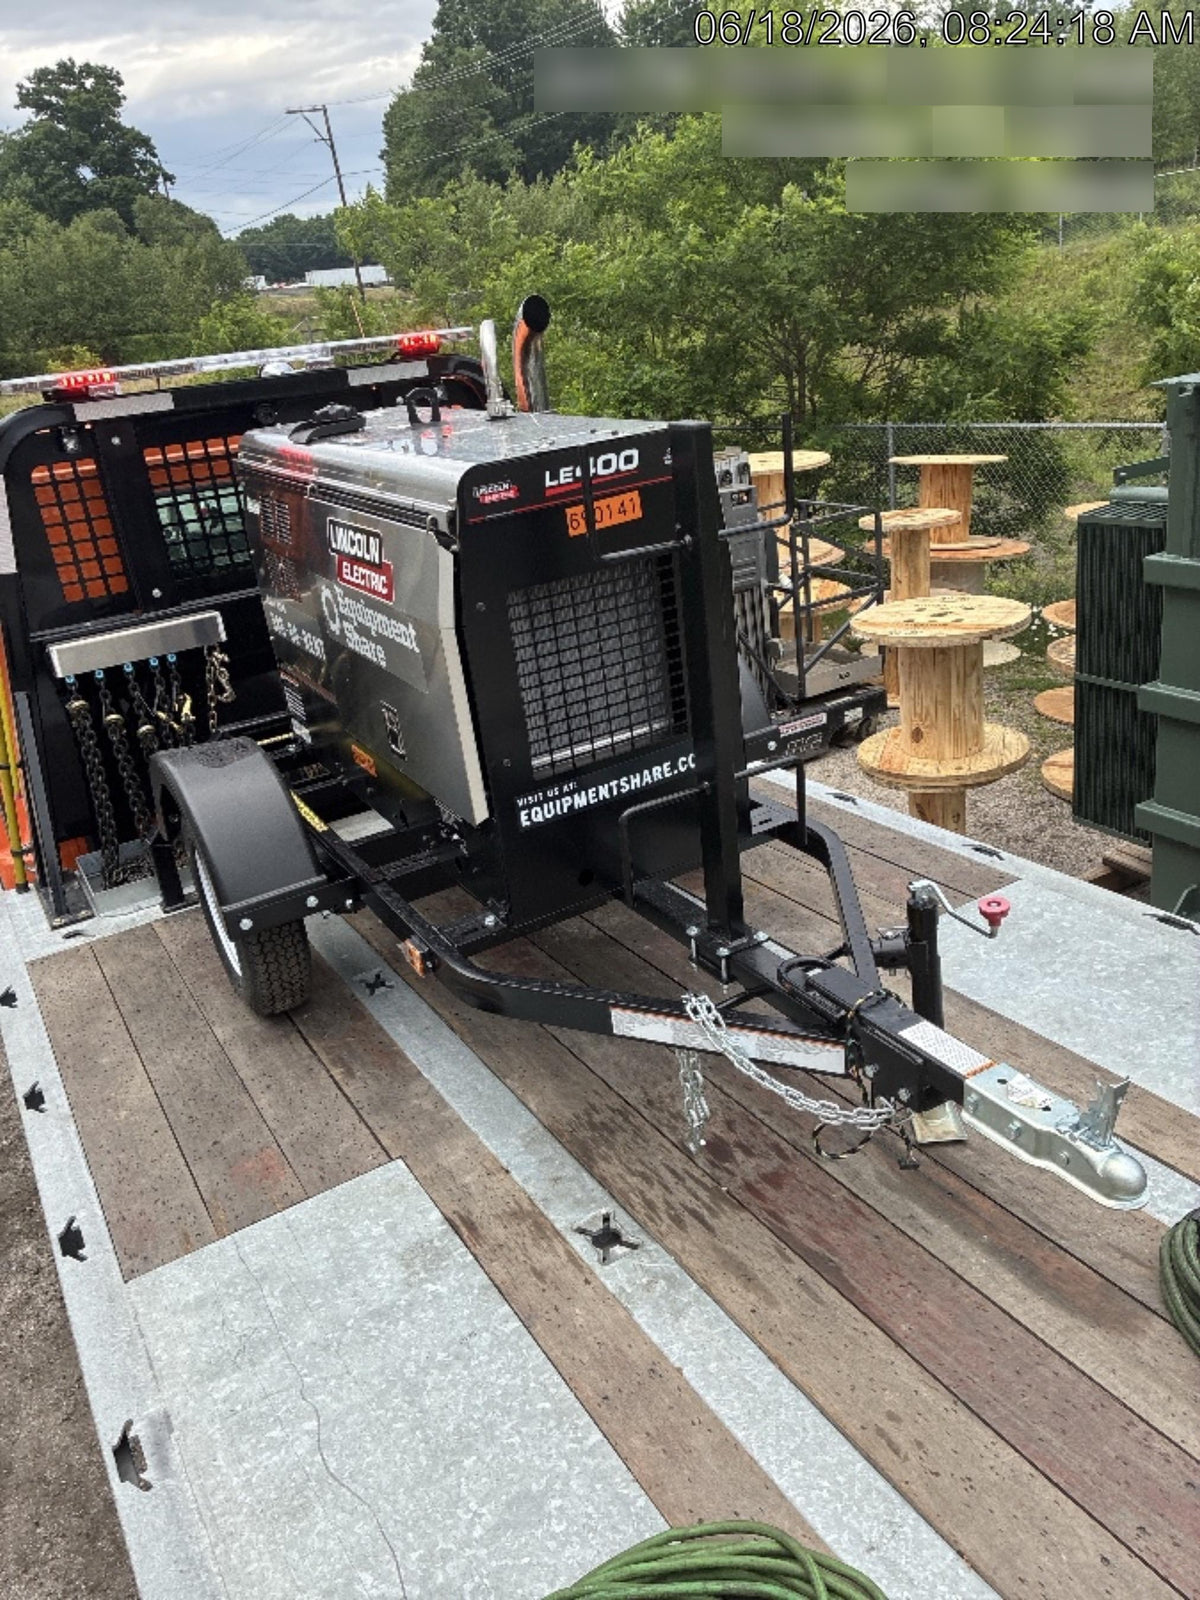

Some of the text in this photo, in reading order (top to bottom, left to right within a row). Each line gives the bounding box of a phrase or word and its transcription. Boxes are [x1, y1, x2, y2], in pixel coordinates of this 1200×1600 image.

[329, 523, 380, 565] LINCOLN
[342, 561, 389, 595] ELECTRIC
[516, 792, 543, 807] VISIT
[547, 787, 559, 798] US
[520, 753, 696, 828] EQUIPMENTSHARE.CO
